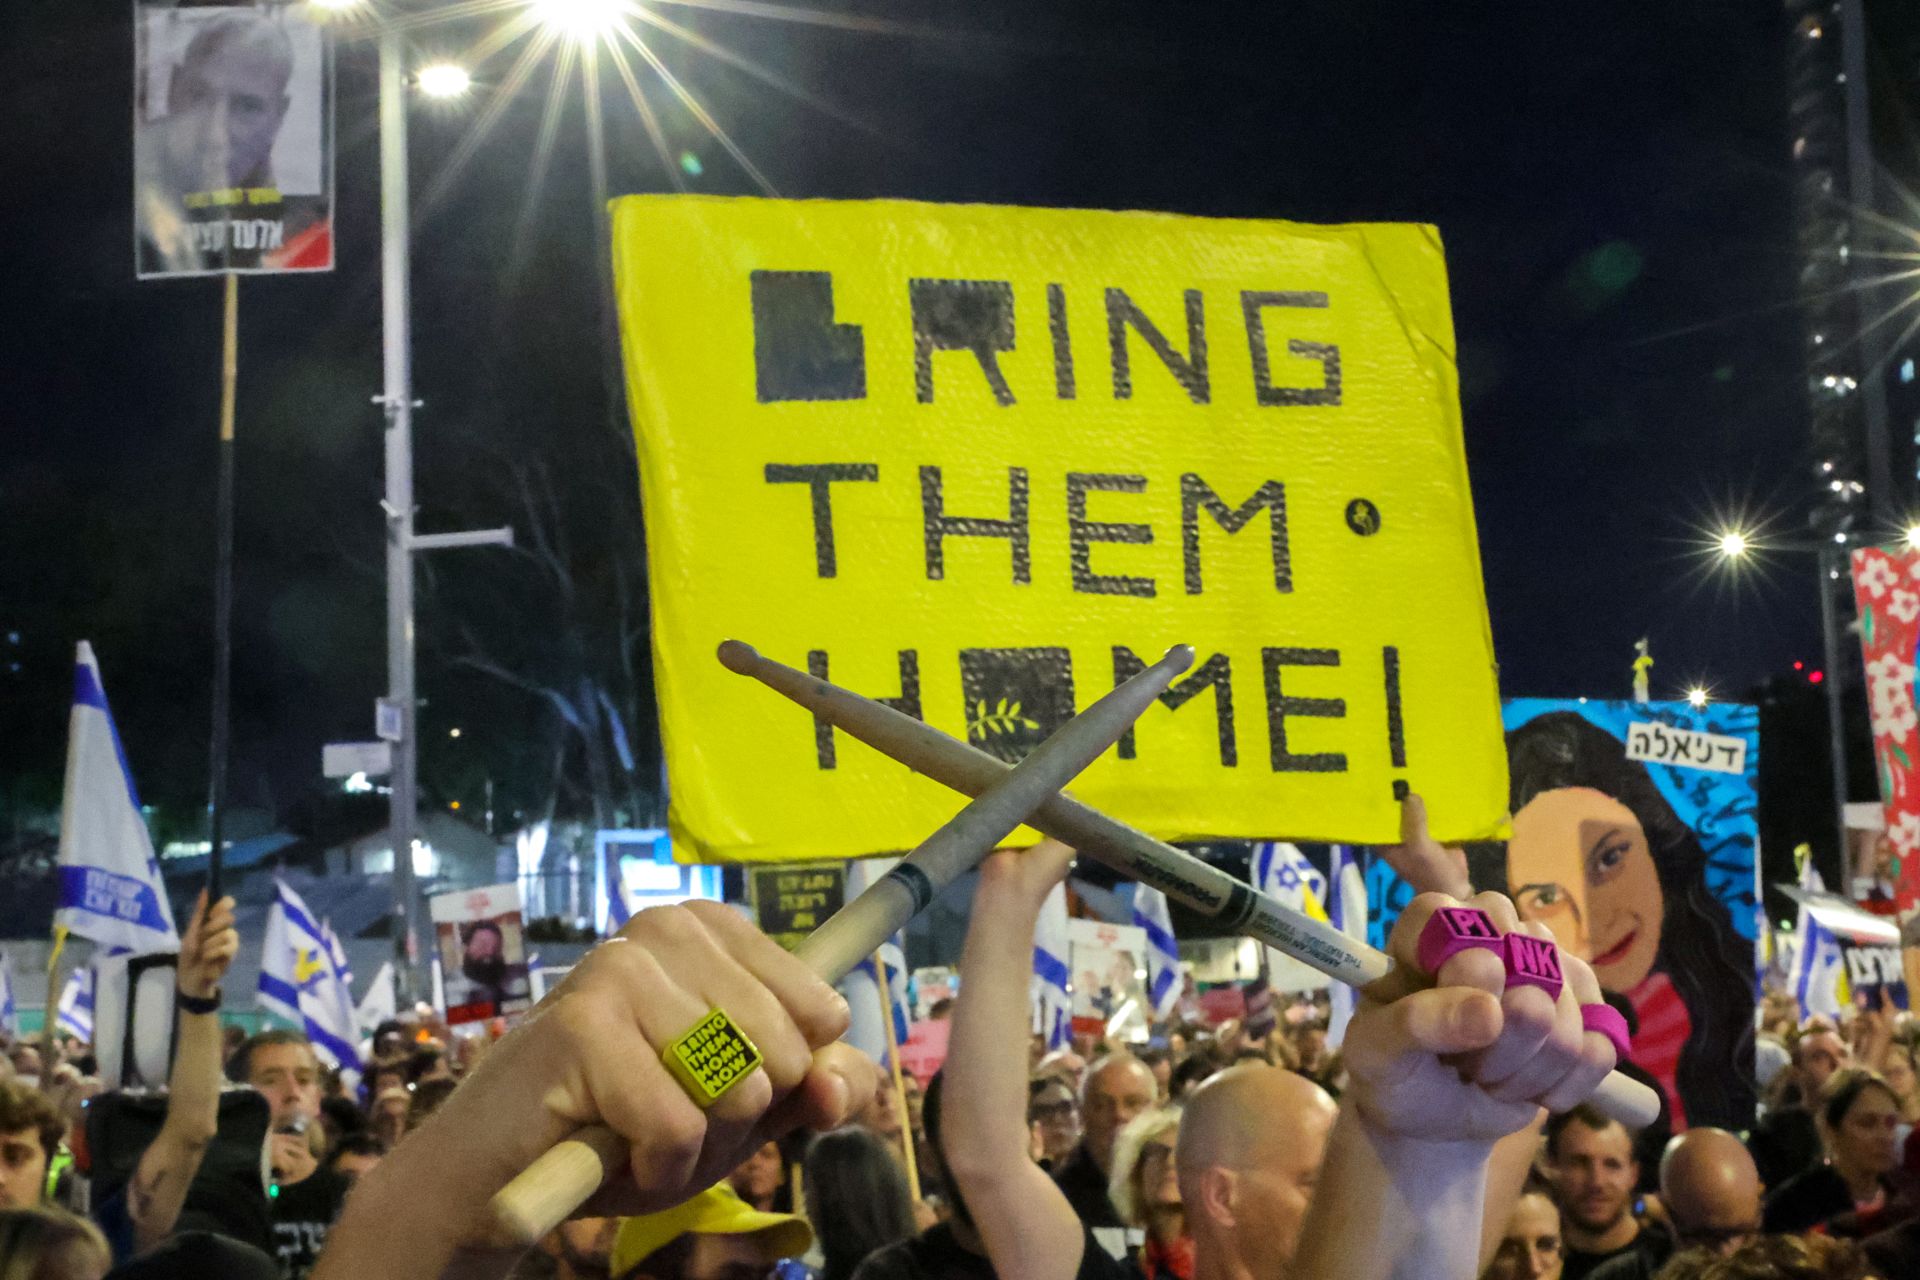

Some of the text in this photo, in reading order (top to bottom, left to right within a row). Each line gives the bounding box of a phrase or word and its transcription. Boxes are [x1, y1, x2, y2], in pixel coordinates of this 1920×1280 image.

[750, 268, 1342, 407] BRING
[764, 462, 1293, 599] THEM
[807, 644, 1410, 801] HOME!
[1634, 727, 1740, 767] דניאלה
[1509, 935, 1560, 980] NK
[678, 1014, 728, 1058] BRING
[686, 1031, 731, 1069] THEM
[697, 1039, 744, 1081] HOME
[706, 1053, 747, 1093] NOW
